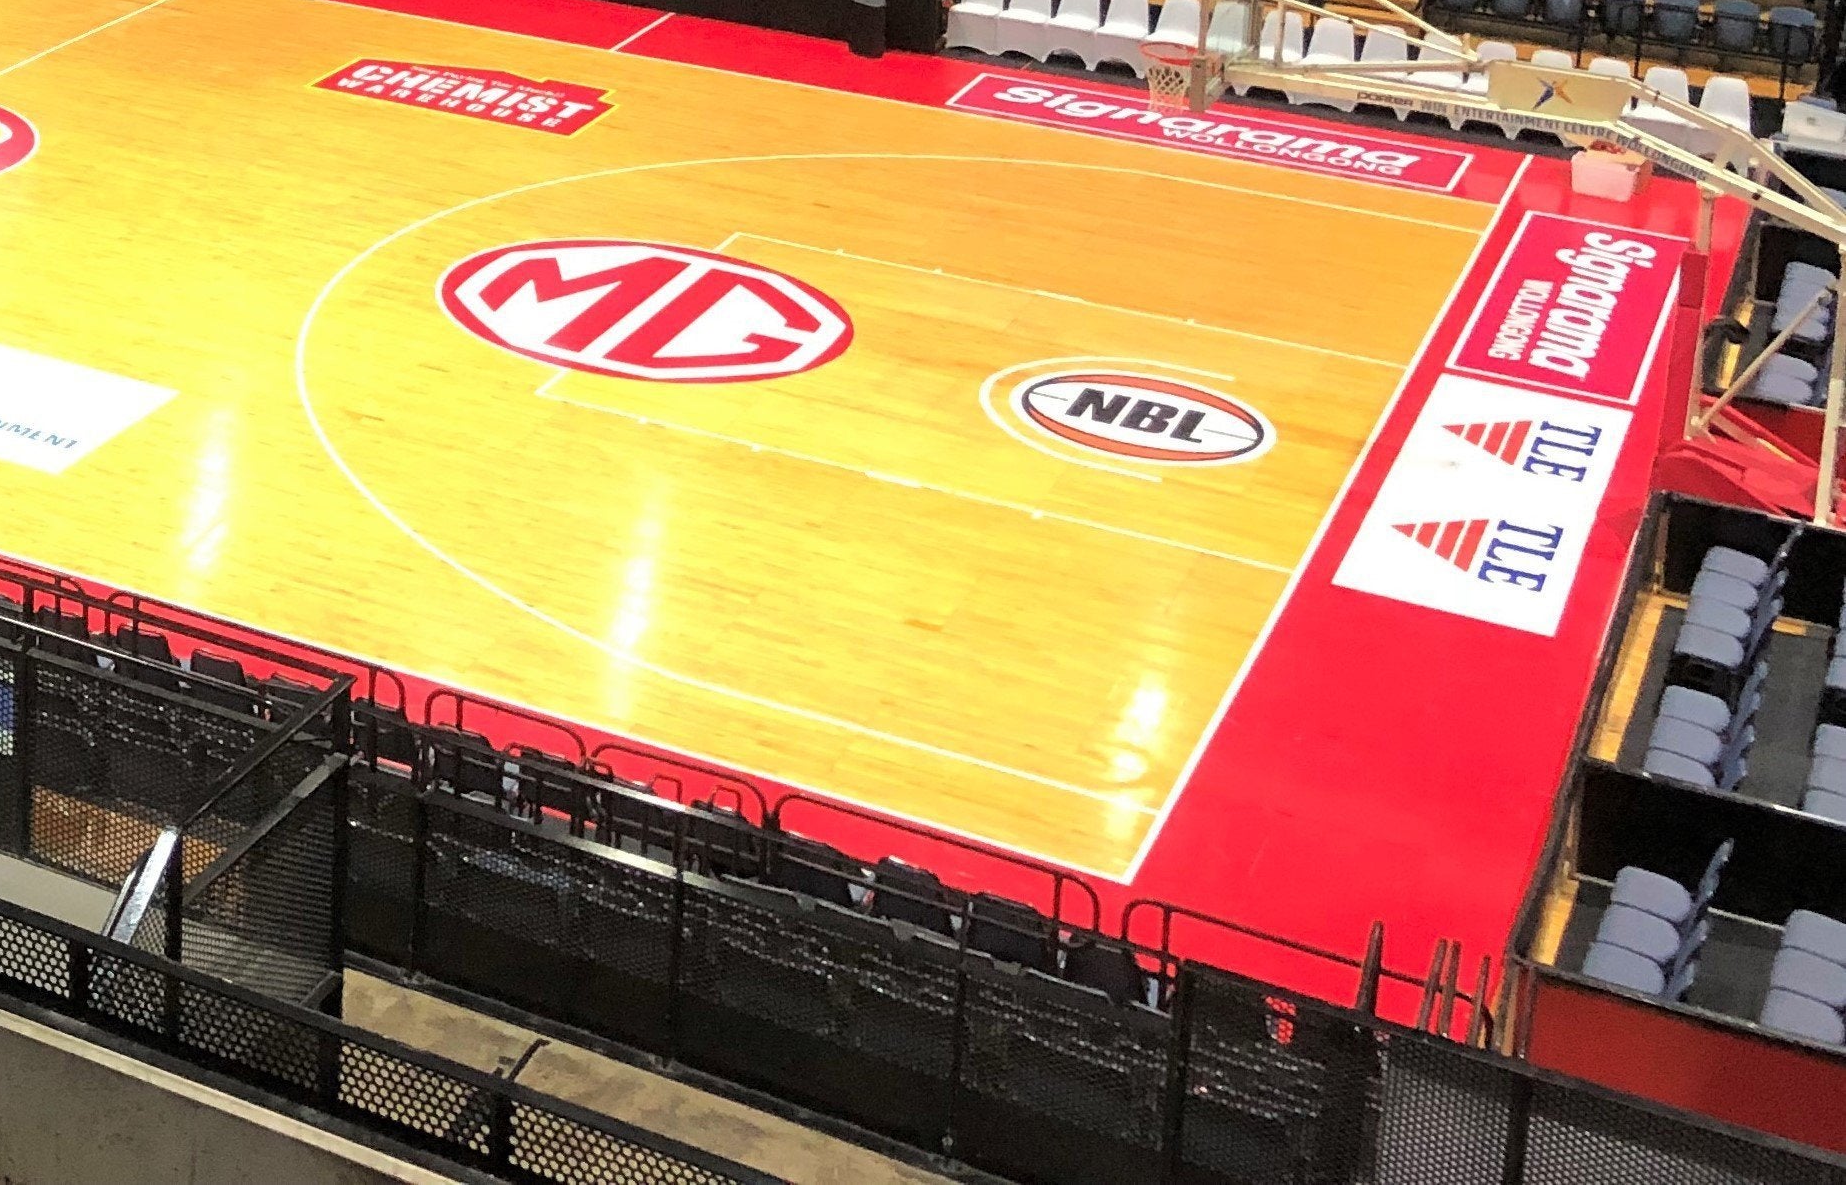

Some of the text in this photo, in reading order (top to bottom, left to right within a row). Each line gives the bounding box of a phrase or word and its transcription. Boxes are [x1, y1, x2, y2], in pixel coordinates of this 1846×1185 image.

[337, 76, 563, 128] WAREHOUSE
[351, 64, 595, 119] CHEMIST
[1419, 99, 1448, 113] WIN
[1453, 104, 1558, 128] ENTERTAINMENT
[1562, 121, 1614, 141] CENTRE
[993, 85, 1421, 169] Signarama
[1162, 126, 1403, 176] WOLLONGONG
[478, 255, 824, 369] MG
[1528, 232, 1657, 381] Signarama
[1064, 387, 1206, 443] NBL
[1522, 420, 1602, 483] TLE
[1477, 519, 1564, 592] TLE
